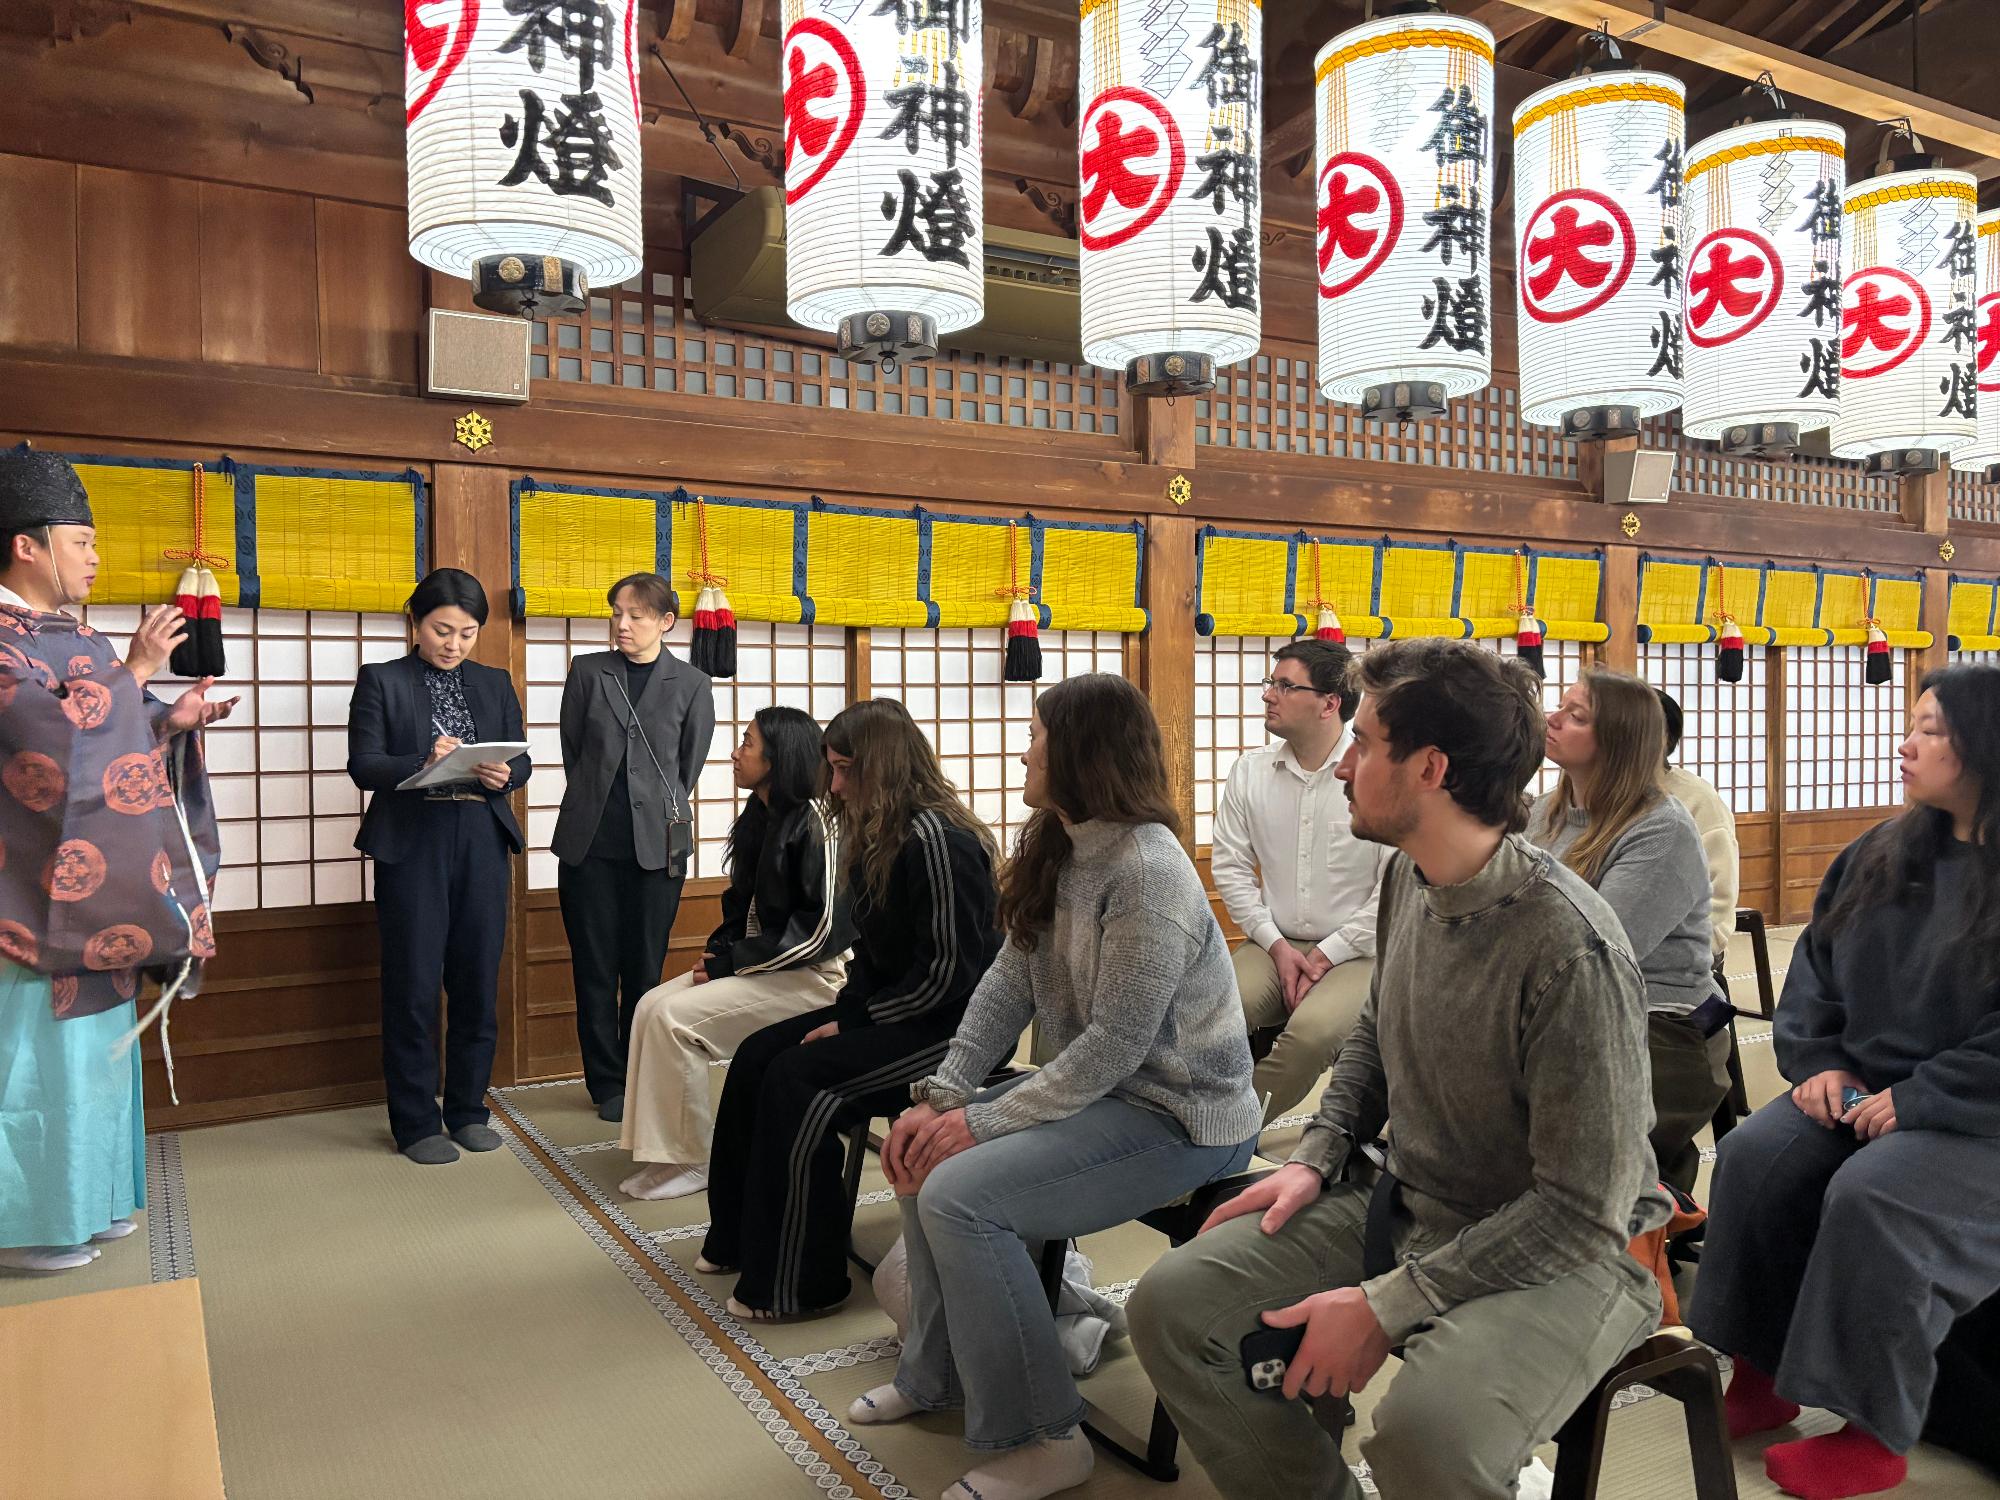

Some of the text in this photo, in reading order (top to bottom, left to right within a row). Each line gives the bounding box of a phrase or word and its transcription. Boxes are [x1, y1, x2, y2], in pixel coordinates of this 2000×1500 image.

[1081, 110, 1160, 223] 大
[1188, 22, 1259, 314] 御神燈
[1318, 172, 1381, 275] 大
[1416, 84, 1488, 356] 御神燈
[1528, 205, 1614, 301] 大
[1689, 243, 1765, 329] 大
[1842, 282, 1912, 358] 大
